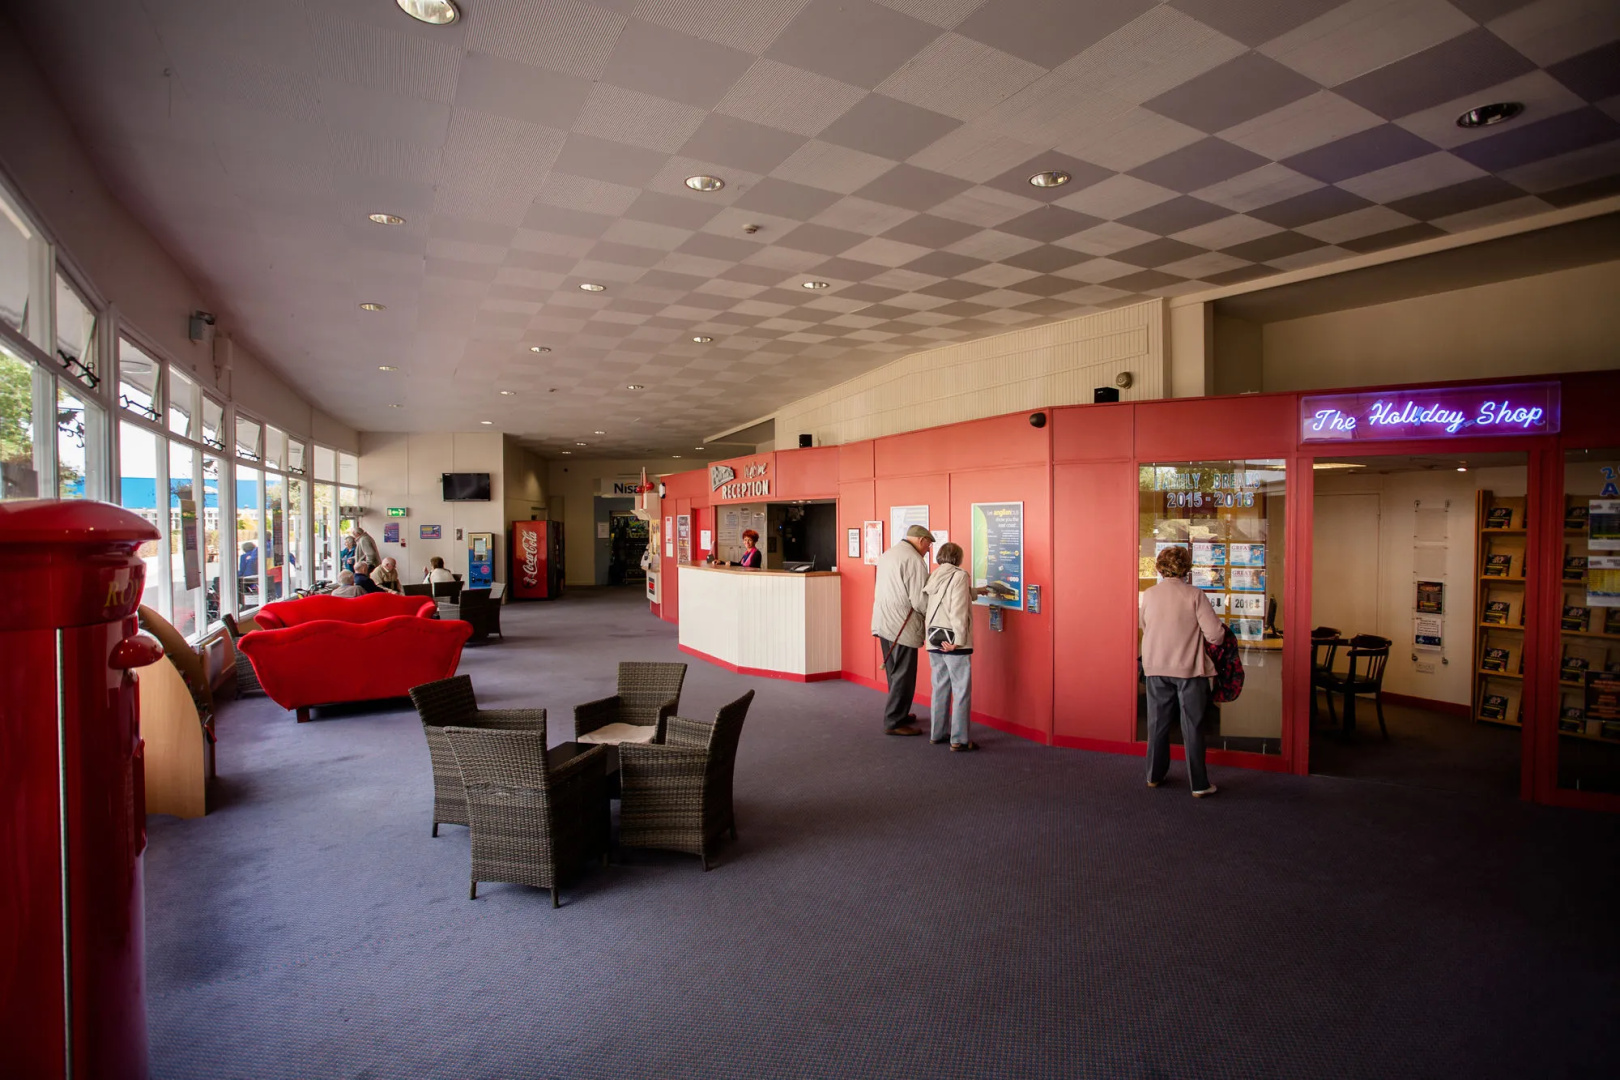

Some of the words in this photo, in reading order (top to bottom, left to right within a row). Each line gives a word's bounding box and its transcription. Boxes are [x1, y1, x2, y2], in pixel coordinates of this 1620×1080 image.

[1312, 409, 1356, 431] The
[1369, 400, 1466, 433] Holiday
[1476, 400, 1546, 428] Shop
[722, 479, 769, 499] RECEPTION
[1154, 473, 1201, 491] FAMILY
[1213, 473, 1260, 489] BREAKS
[1235, 598, 1254, 609] 2016
